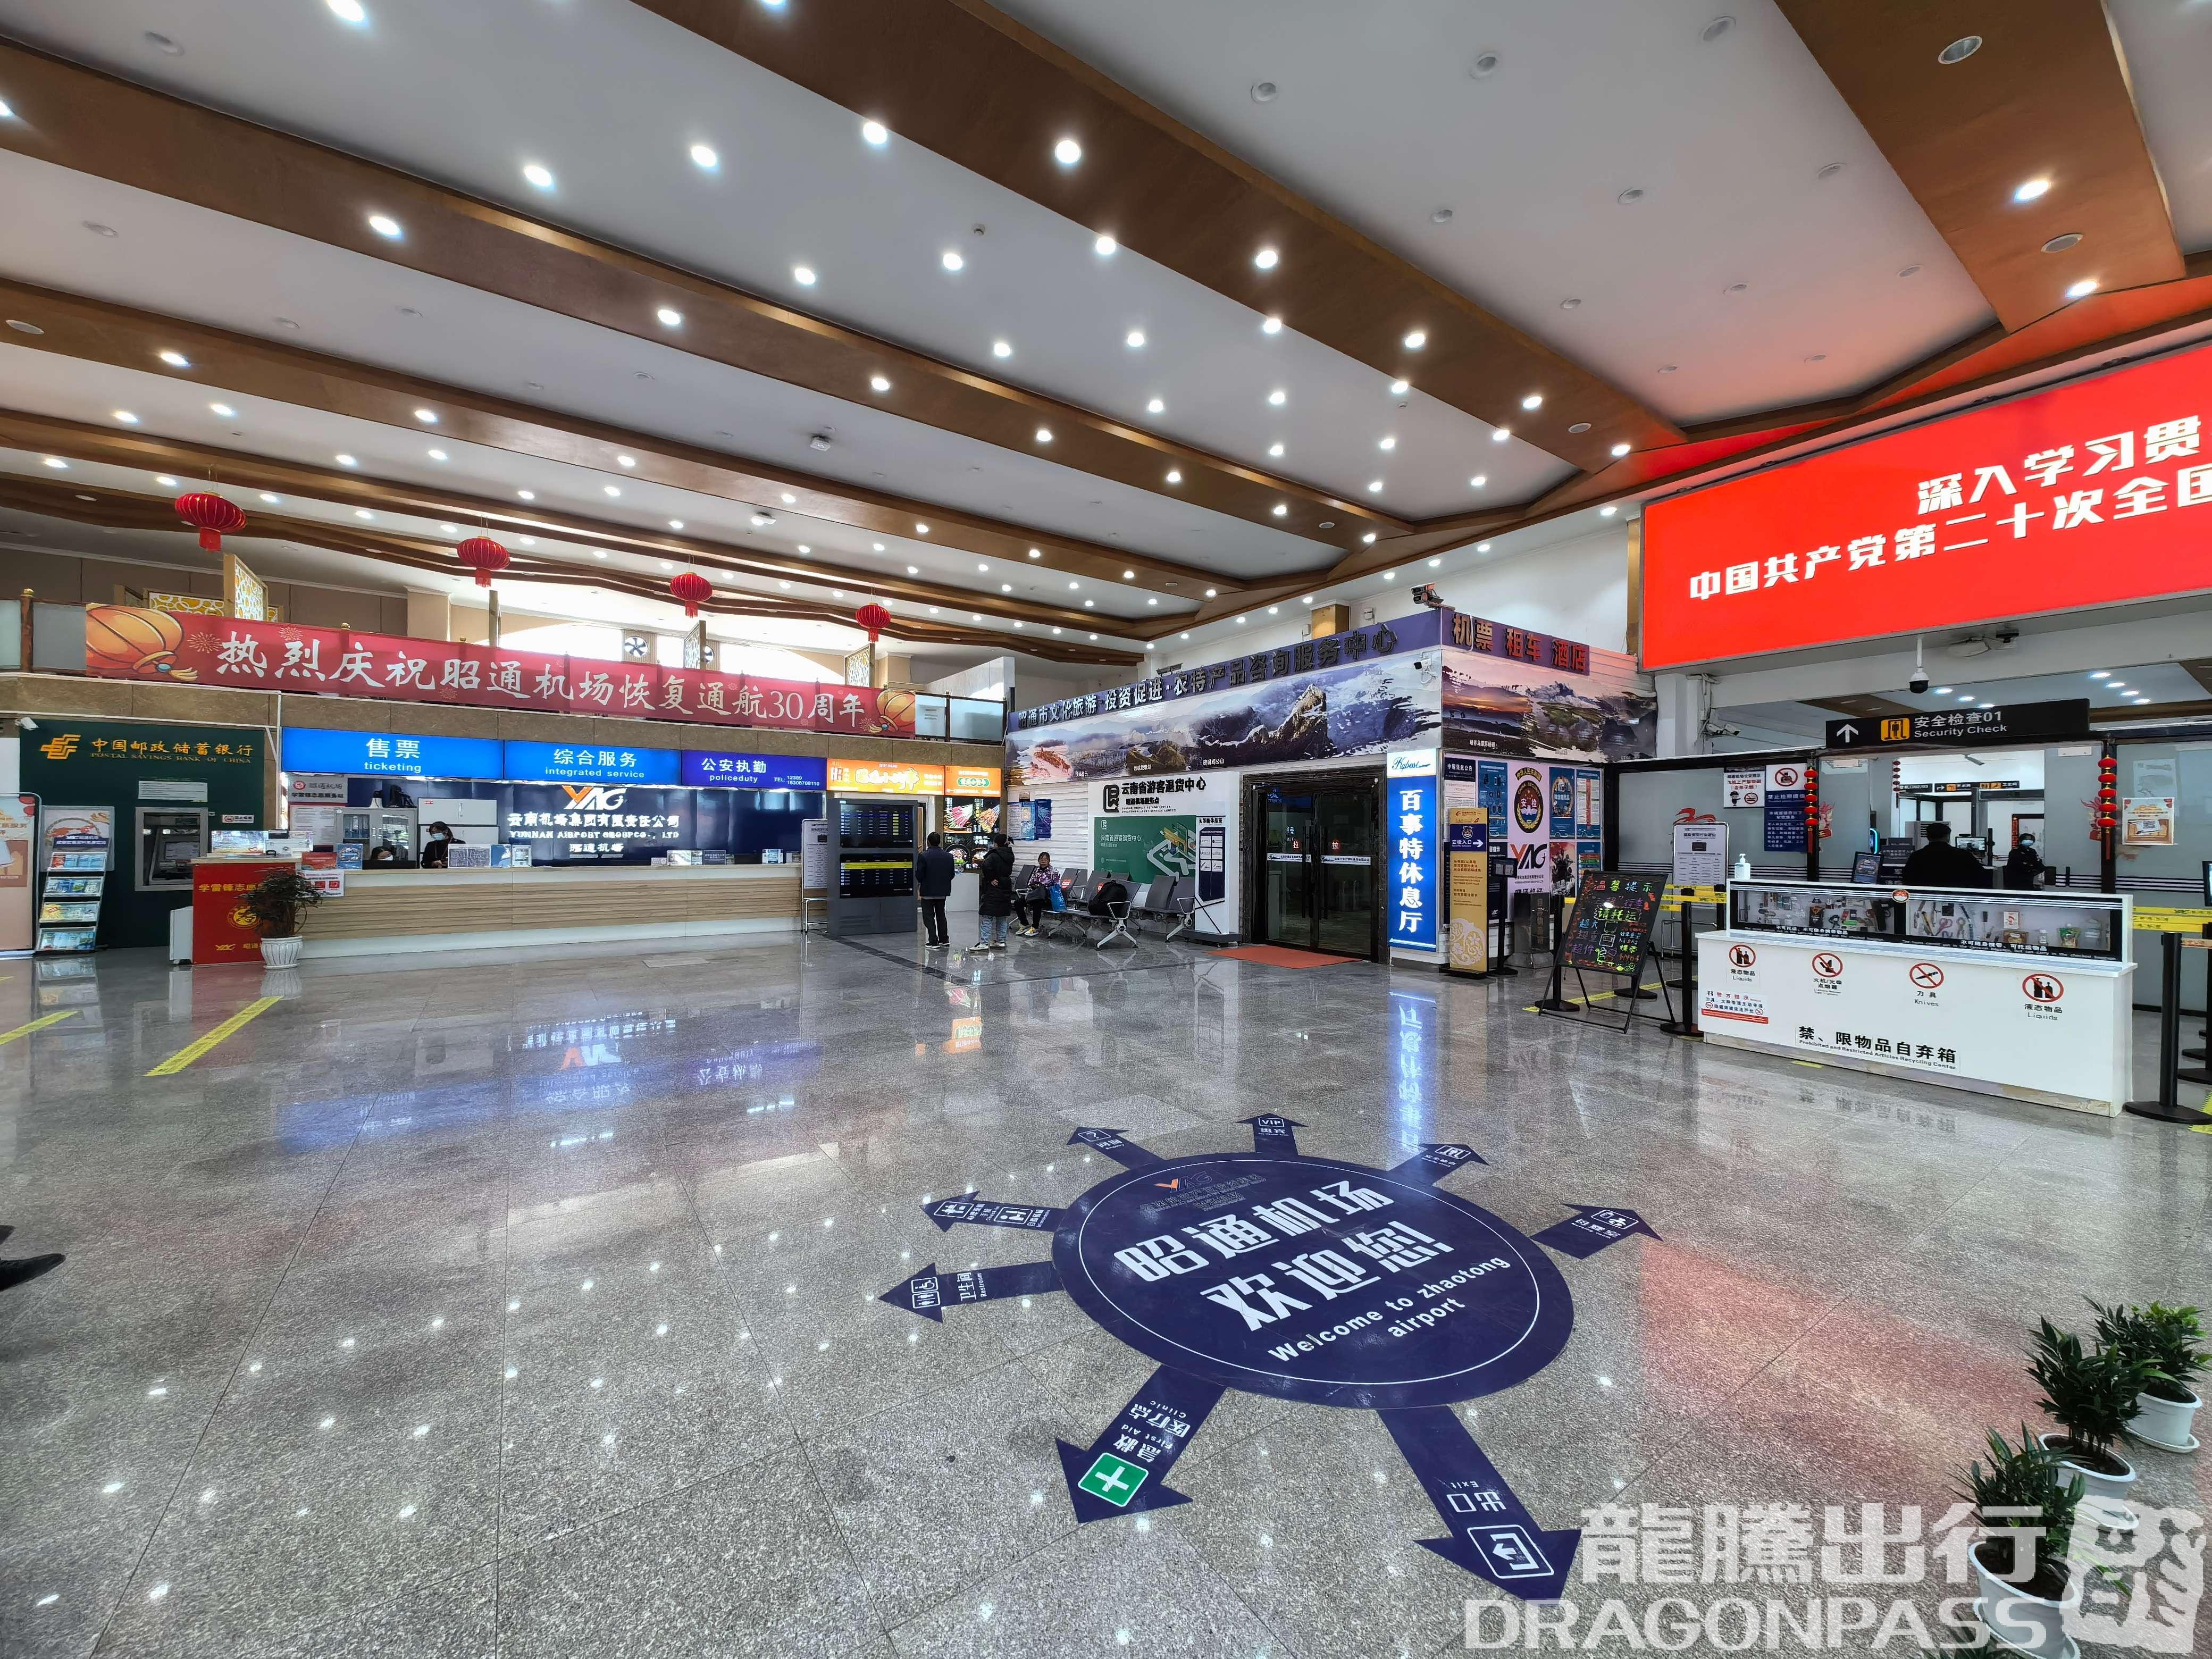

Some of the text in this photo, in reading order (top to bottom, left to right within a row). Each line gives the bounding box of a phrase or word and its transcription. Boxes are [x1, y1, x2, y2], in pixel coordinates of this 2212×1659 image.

[1918, 416, 2200, 515] 深入学习贯
[1453, 613, 1586, 672] 机票 租车 酒店
[216, 631, 865, 727] 热烈庆祝昭通机场恢复通航30周年
[1915, 711, 2001, 727] 安全检查01
[1915, 724, 2007, 738] Security Check
[91, 738, 254, 756] 中国邮政储蓄银行
[365, 738, 421, 759] 售票
[364, 761, 422, 775] ticketing
[554, 749, 637, 767] 综合服务
[701, 758, 767, 773] 公安执勤
[545, 767, 601, 777] integrated
[710, 774, 758, 783] policeduty
[1121, 776, 1206, 794] 云南省游客退货中心
[507, 812, 679, 828] 云南机场集团有限责任公司
[569, 843, 624, 853] 昭通机场
[1398, 789, 1424, 933] 百事特休息厅
[1598, 908, 1637, 920] 请托运
[2024, 1003, 2062, 1013] 液态物品
[2027, 1011, 2058, 1020] Liquids
[1799, 1026, 1957, 1063] 禁、限物品自弃箱
[1799, 1040, 1829, 1048] Prohibited
[1842, 1046, 1873, 1055] Restricted
[1900, 1056, 1932, 1066] Recycling
[1114, 1180, 1394, 1282] 昭通机场
[957, 1272, 976, 1302] 卫生间
[977, 1272, 987, 1297] Restroom
[1268, 1256, 1511, 1361] Welcome to zhaotong
[1387, 1297, 1466, 1337] airport
[1150, 1401, 1186, 1418] Clinic
[1128, 1403, 1191, 1438] 医疗点
[1121, 1424, 1174, 1449] First Aid
[1113, 1434, 1162, 1462] 急救
[1446, 1492, 1506, 1513] 出口
